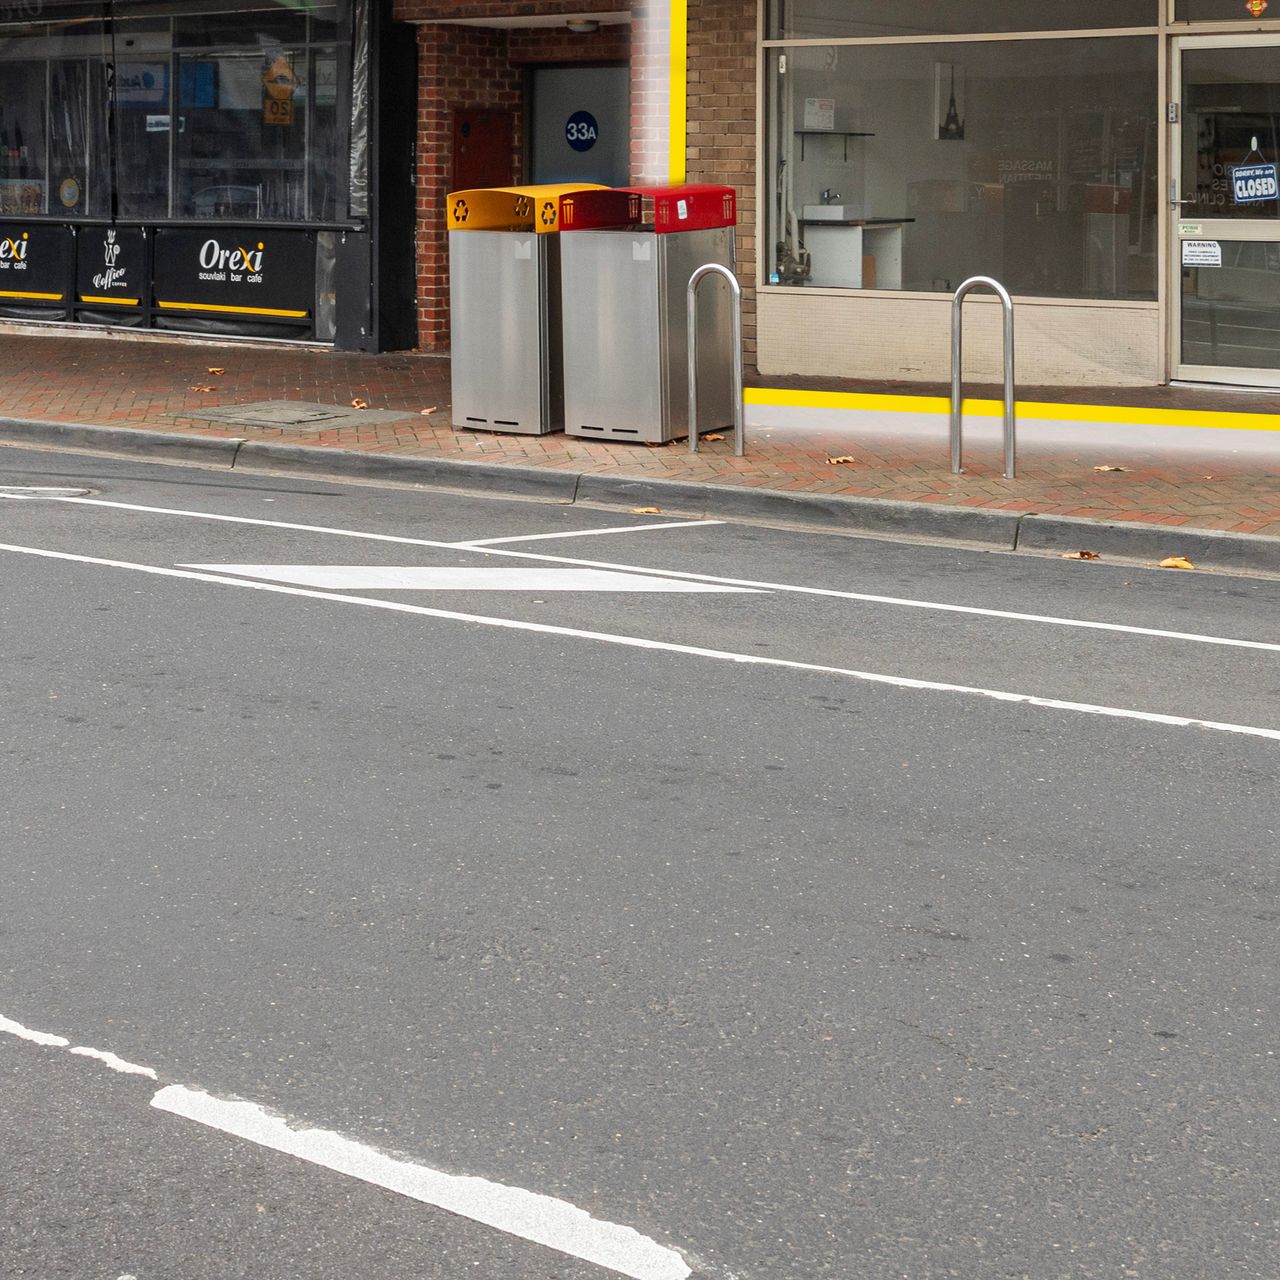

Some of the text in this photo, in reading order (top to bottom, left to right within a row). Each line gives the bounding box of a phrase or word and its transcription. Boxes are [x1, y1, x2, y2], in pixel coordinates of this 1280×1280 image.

[567, 123, 597, 140] 33A
[1236, 178, 1276, 197] CLOSED
[199, 239, 264, 272] Orexi
[199, 271, 226, 280] souvlaki
[231, 272, 242, 281] bar
